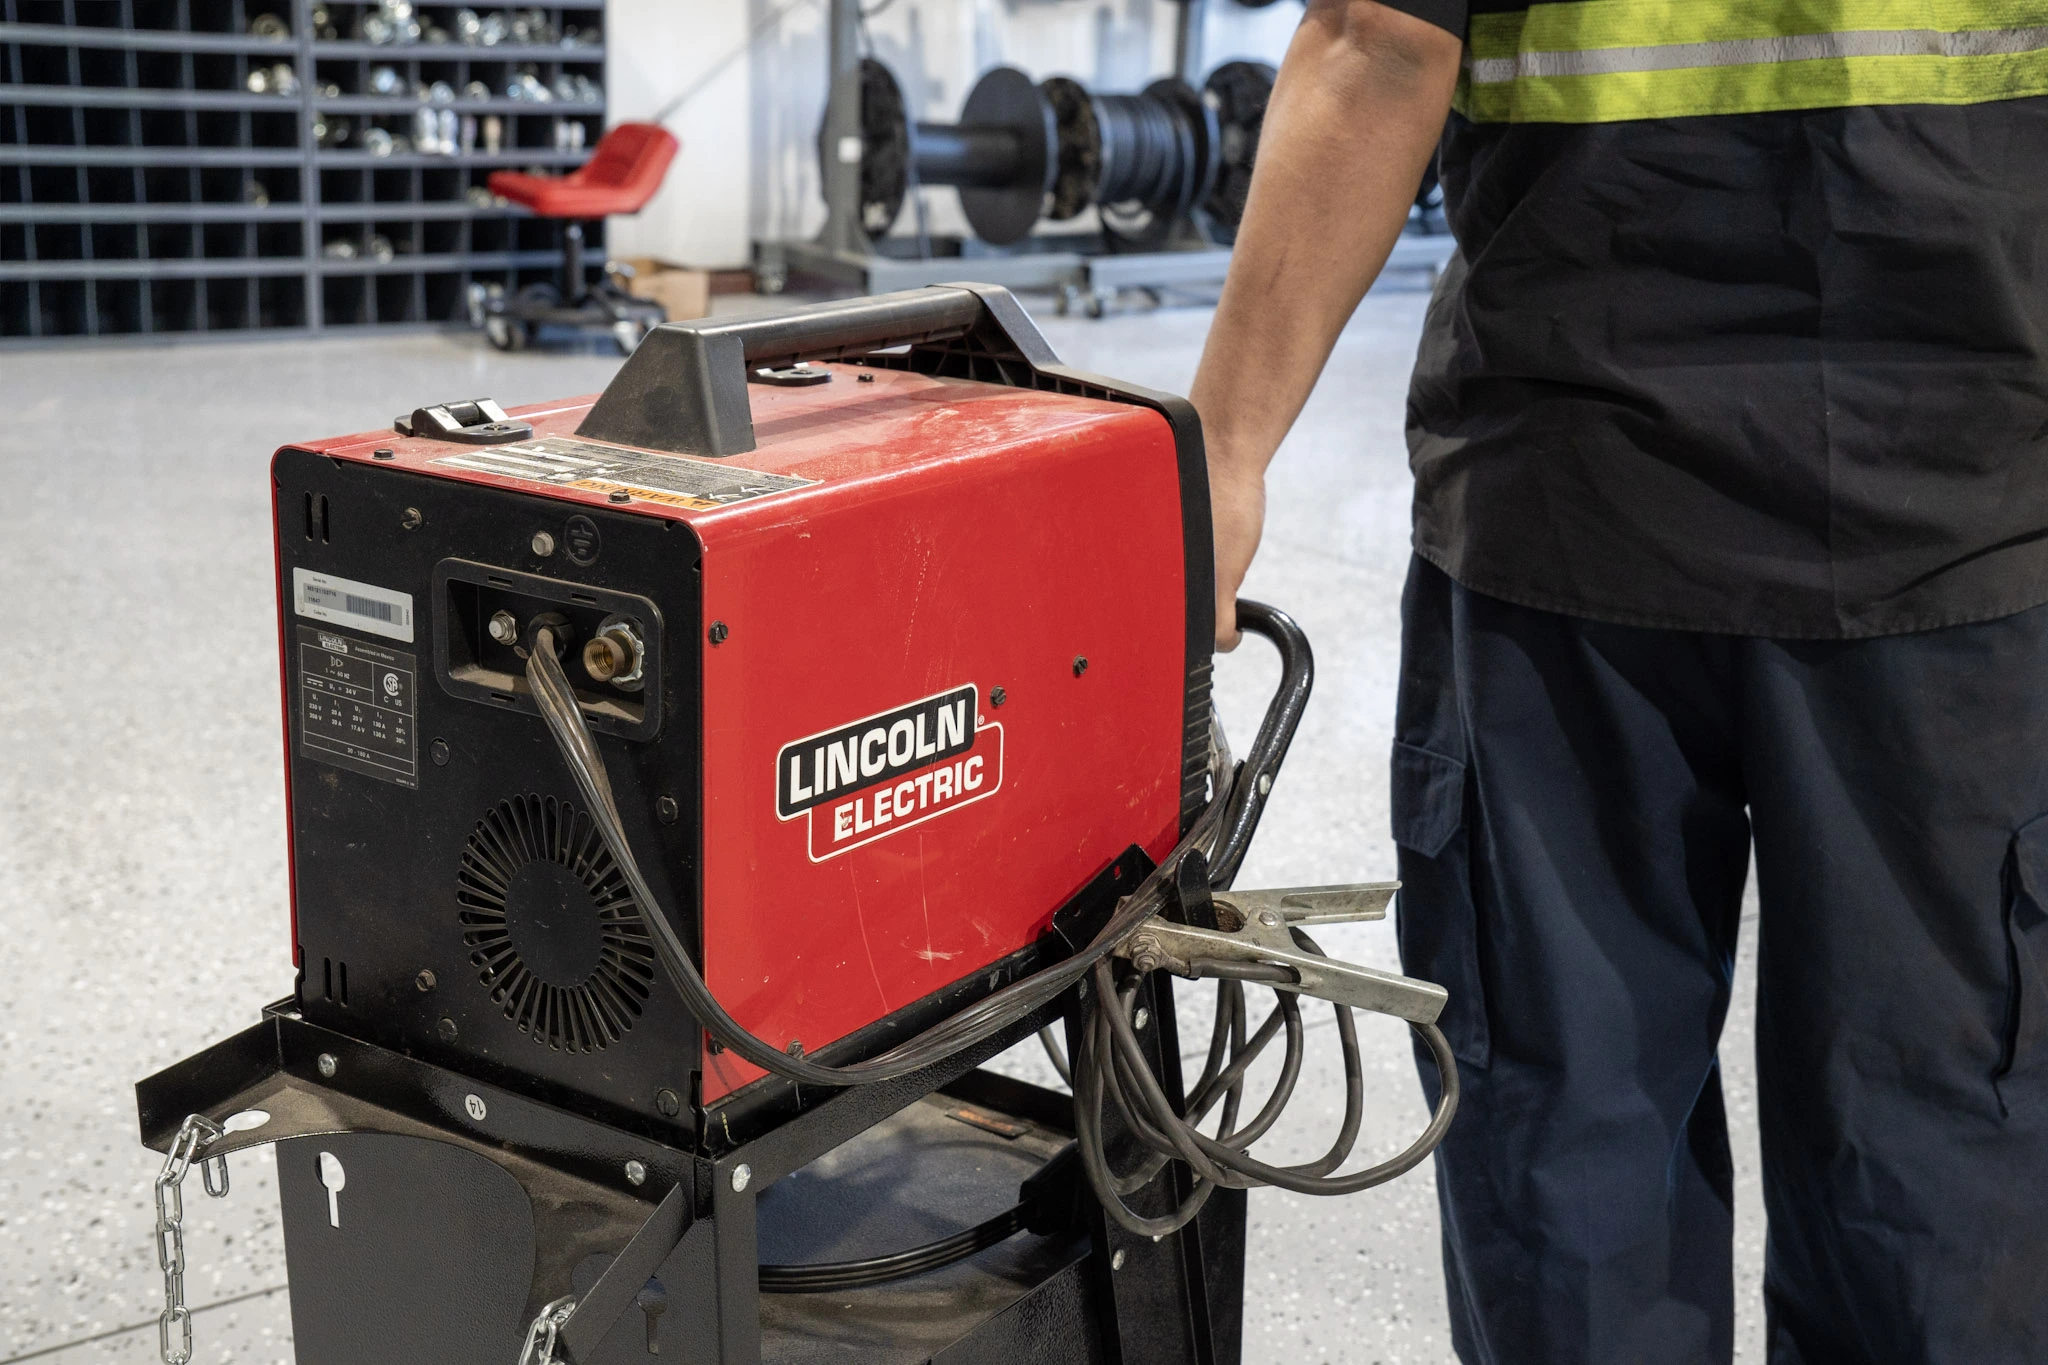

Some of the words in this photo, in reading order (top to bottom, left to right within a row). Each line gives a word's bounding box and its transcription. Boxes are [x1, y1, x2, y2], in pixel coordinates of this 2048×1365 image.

[319, 633, 343, 646] LINCOLN
[325, 642, 346, 652] ELECTRIC
[354, 646, 376, 657] Assembled
[381, 652, 395, 662] Mexico
[383, 695, 389, 703] C
[394, 698, 403, 707] US
[790, 699, 966, 805] LINCOLN
[832, 755, 984, 842] ELECTRIC
[469, 1099, 484, 1116] 14
